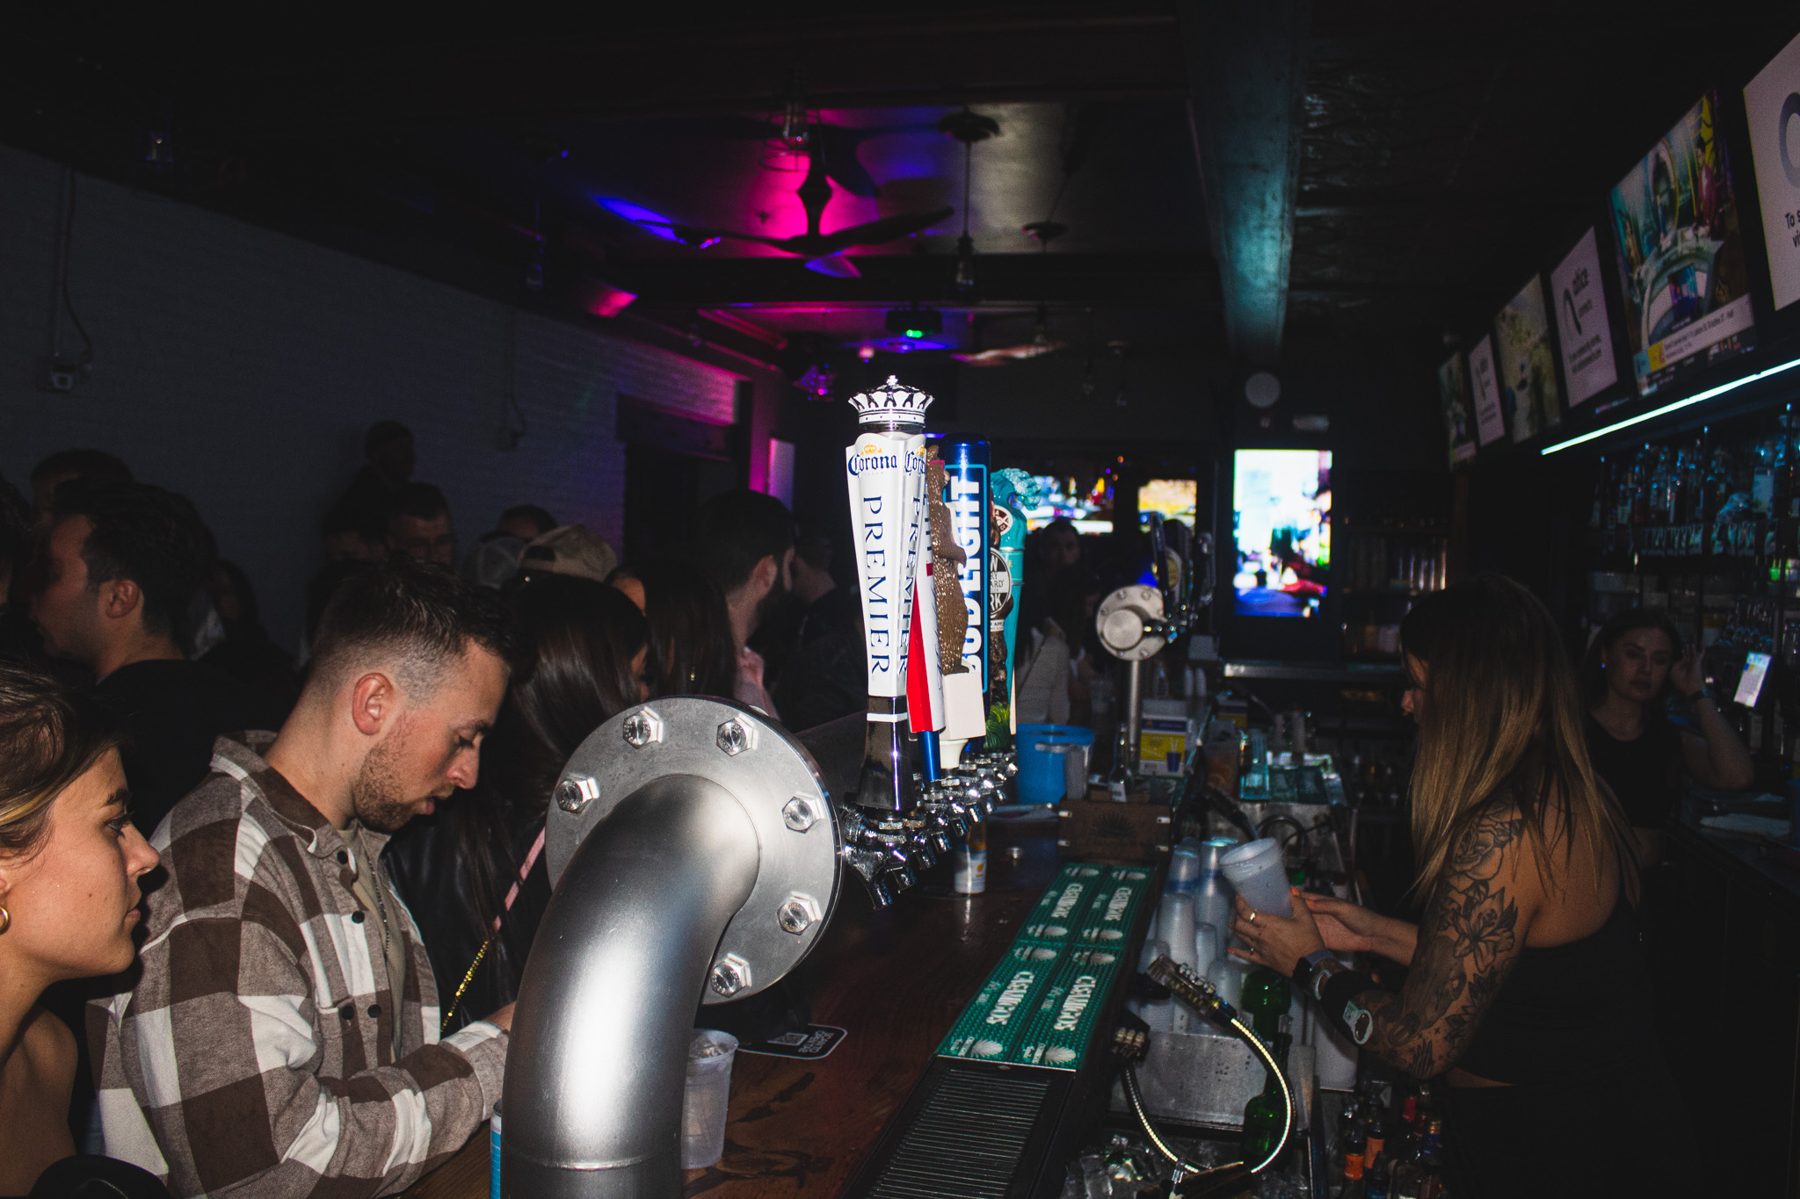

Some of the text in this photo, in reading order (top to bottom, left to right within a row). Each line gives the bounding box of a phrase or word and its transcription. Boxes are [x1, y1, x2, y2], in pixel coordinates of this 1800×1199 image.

[848, 454, 898, 476] Corona
[947, 476, 980, 595] LIGHT
[863, 496, 890, 674] PREMIER
[899, 497, 921, 674] PREMIER
[986, 970, 1035, 1026] CASAMIGOS
[1053, 974, 1097, 1031] CASAMIGOS
